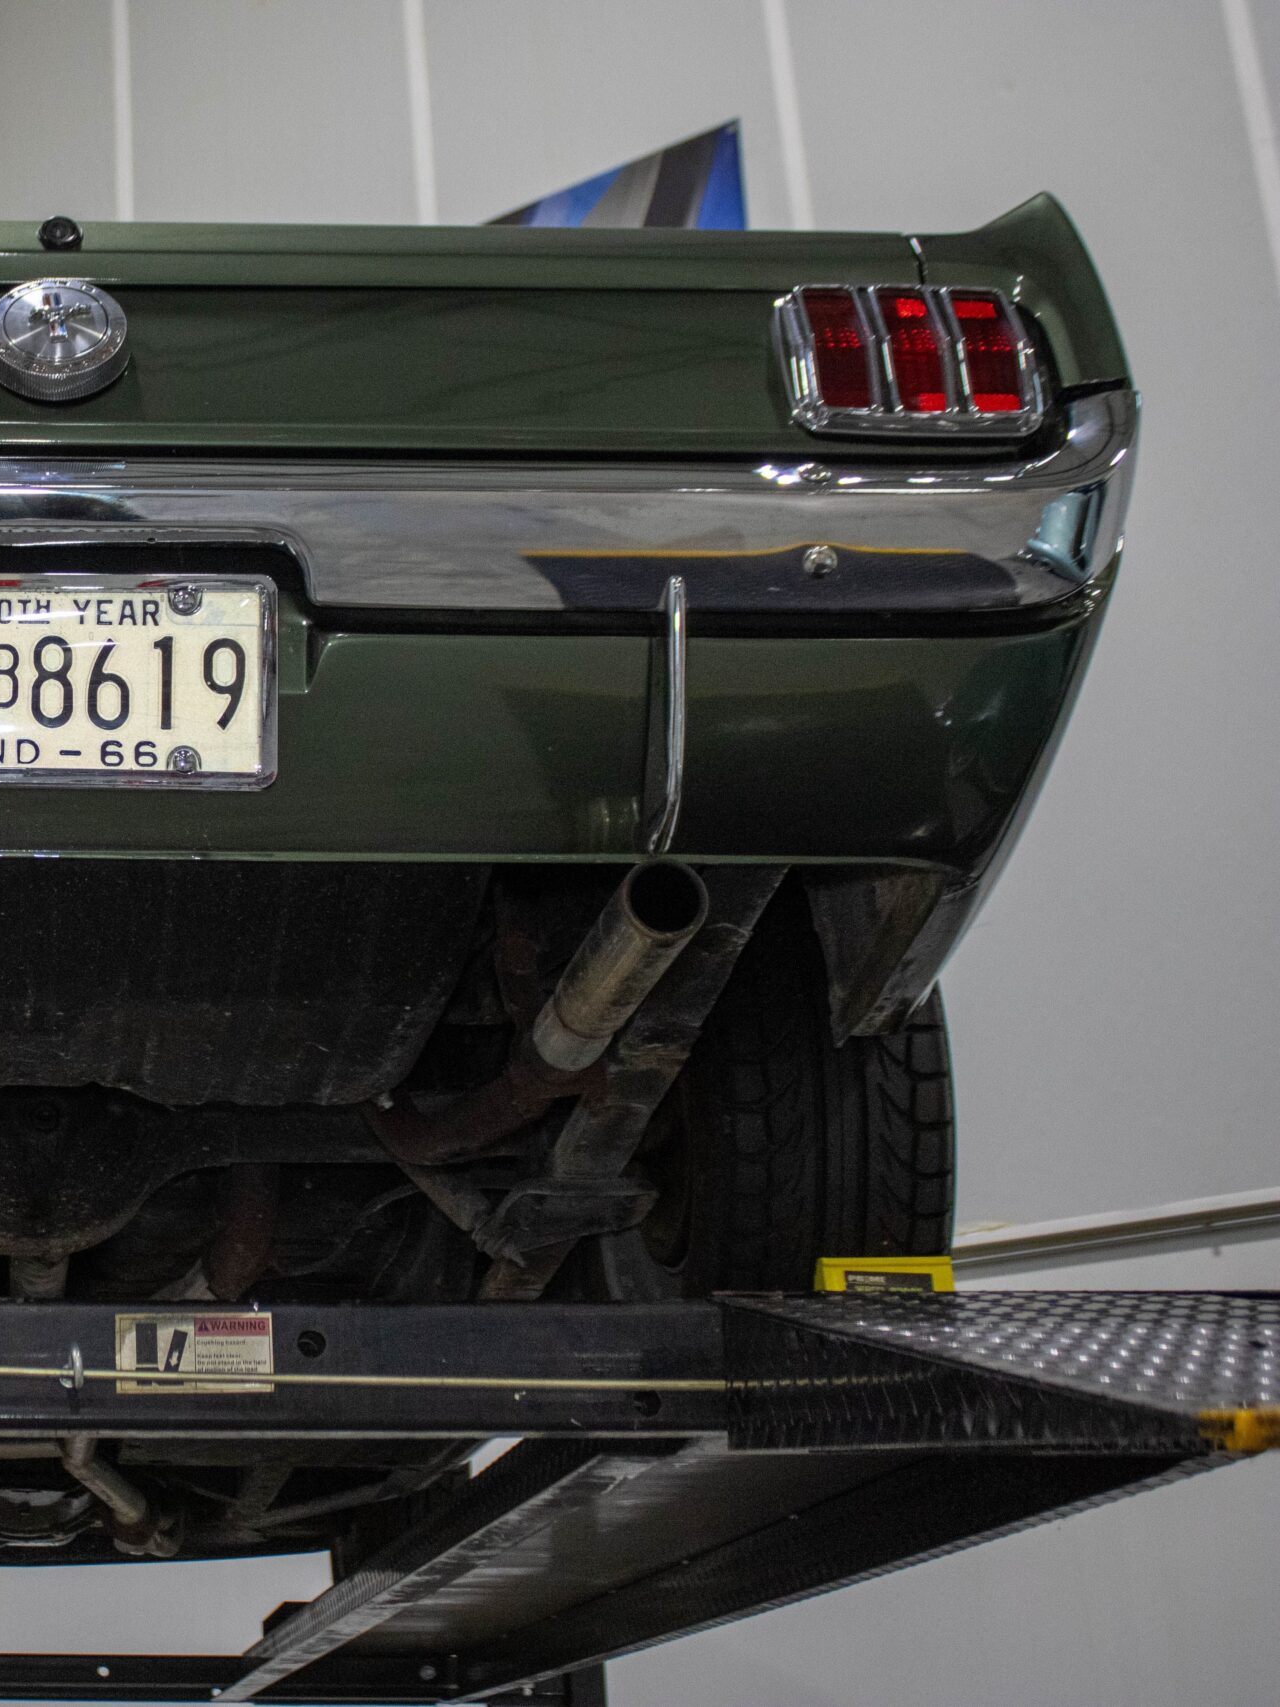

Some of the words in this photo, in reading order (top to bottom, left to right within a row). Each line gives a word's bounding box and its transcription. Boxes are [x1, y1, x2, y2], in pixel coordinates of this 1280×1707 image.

[73, 600, 160, 626] YEAR
[100, 740, 158, 767] 66
[210, 1320, 266, 1331] WARNING
